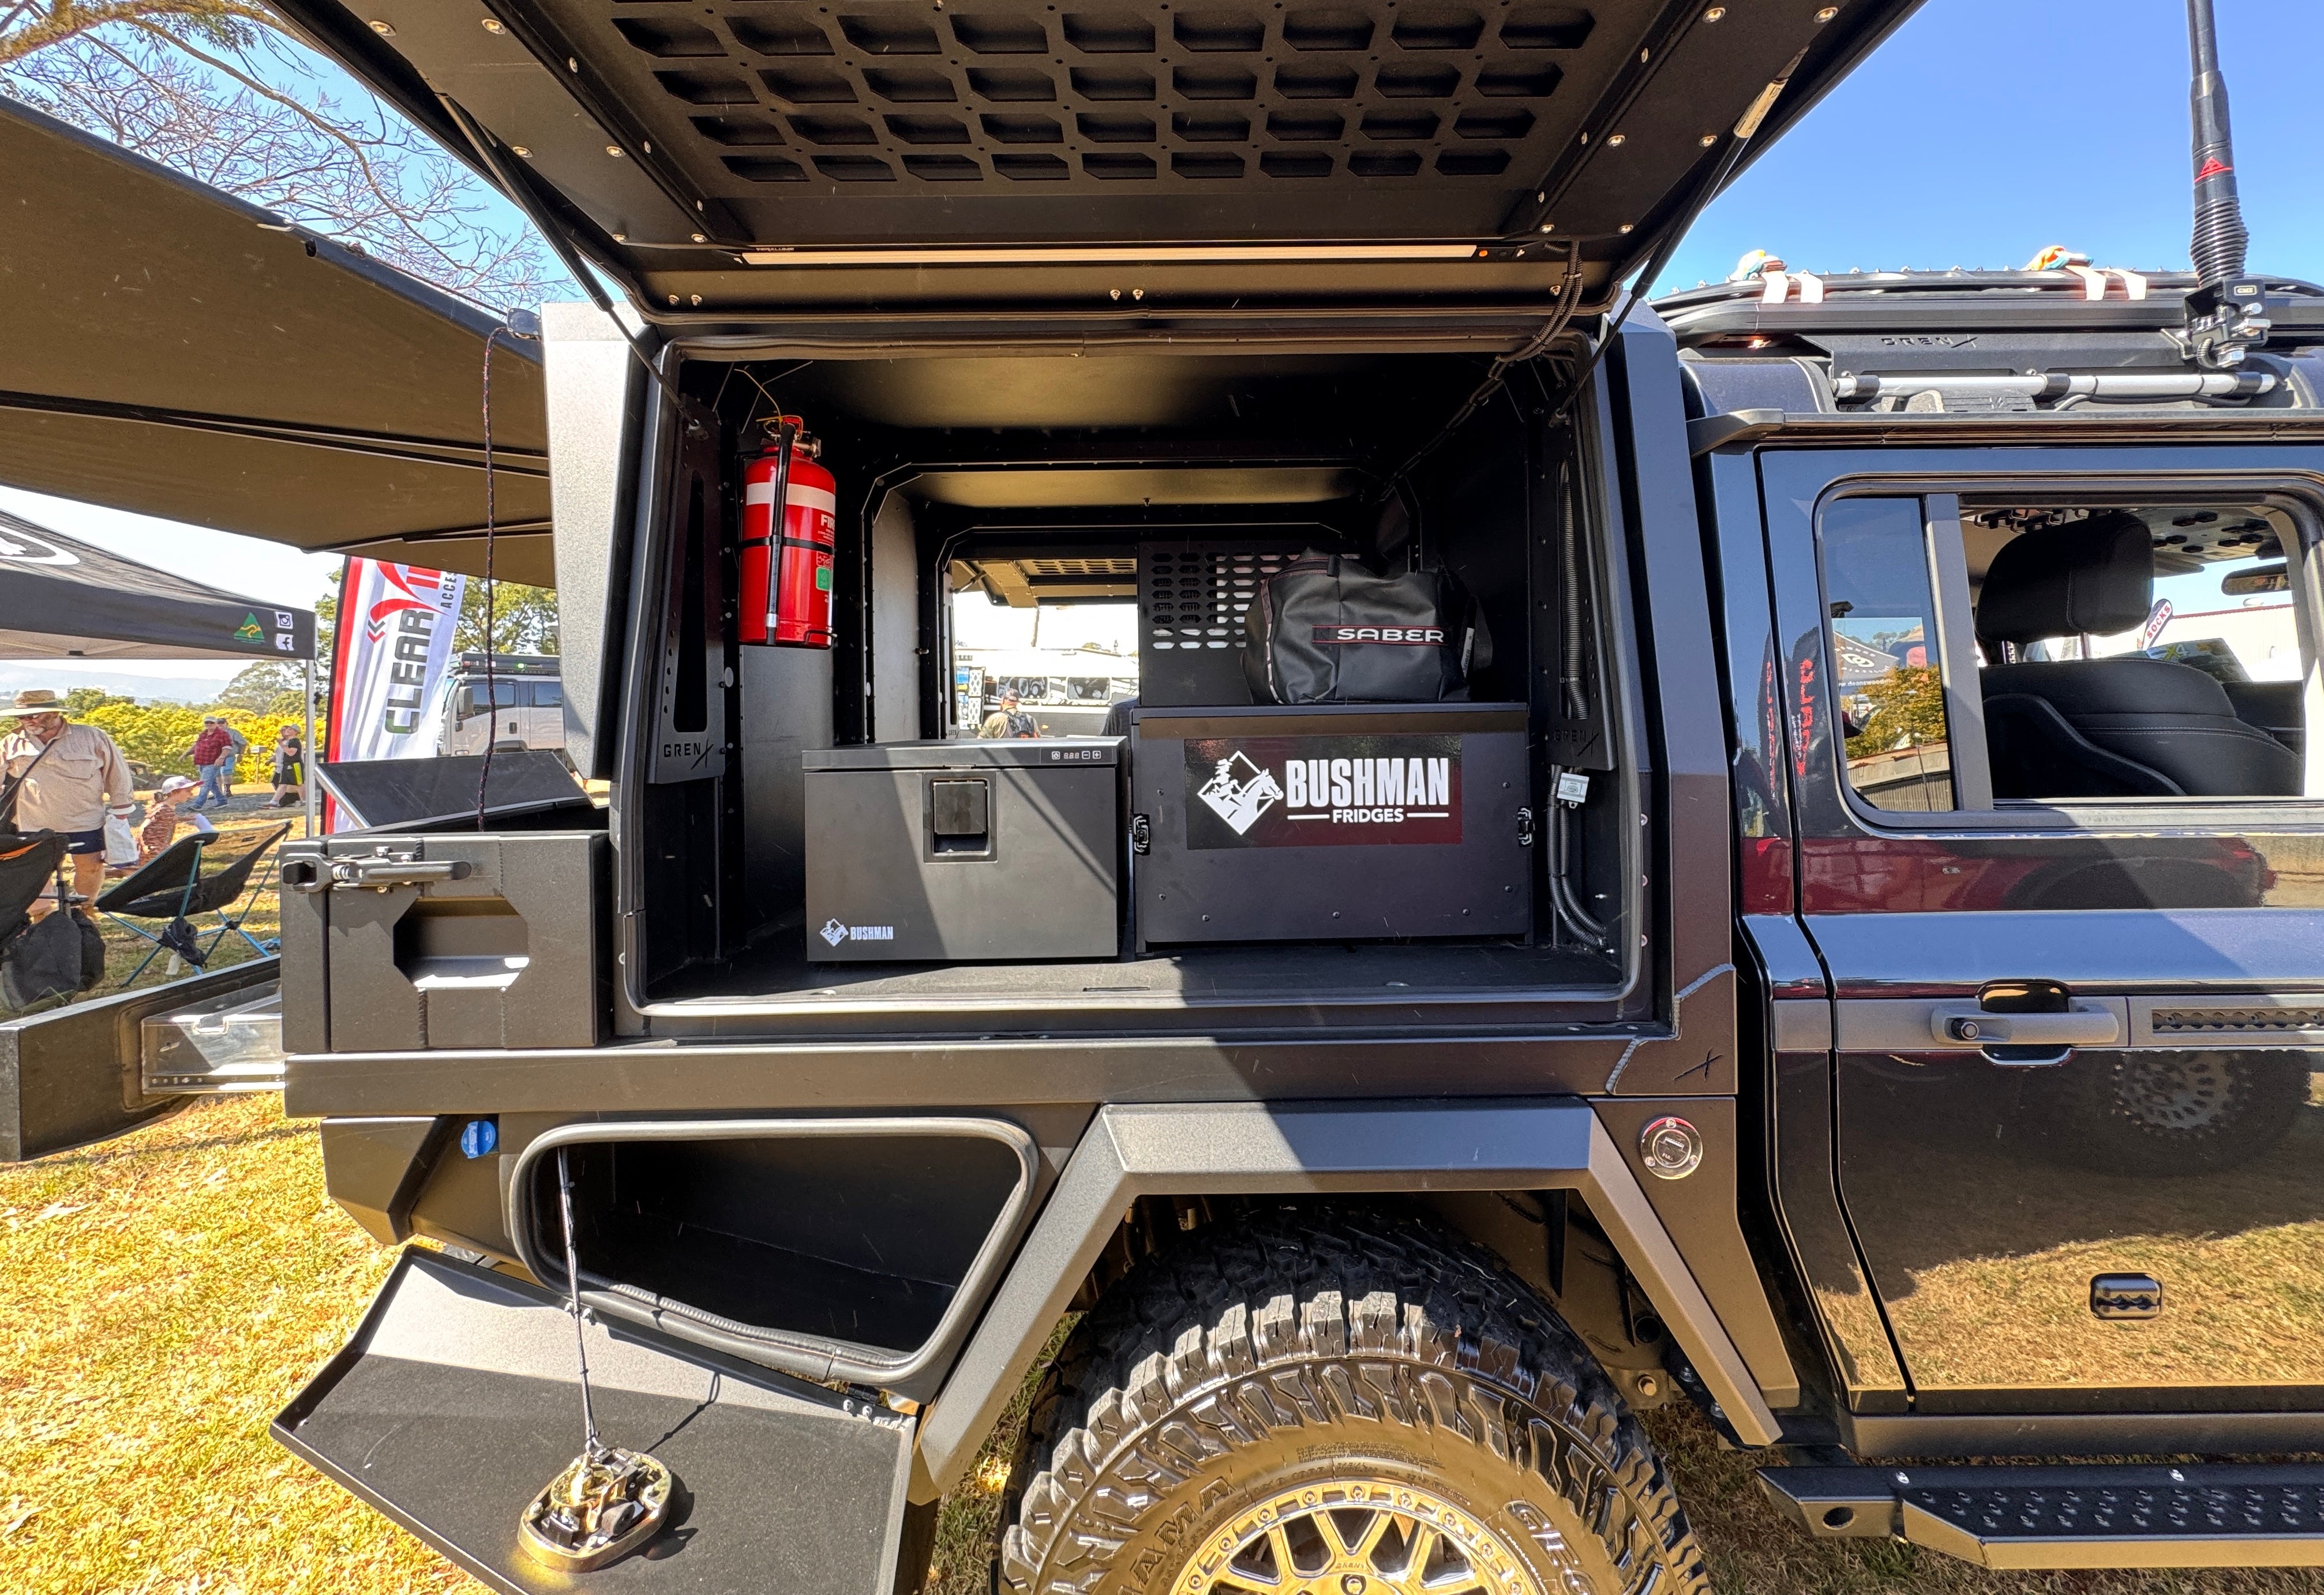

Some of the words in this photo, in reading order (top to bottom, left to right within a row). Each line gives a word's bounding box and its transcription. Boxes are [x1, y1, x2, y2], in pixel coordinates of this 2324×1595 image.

[820, 513, 835, 530] FIR
[2146, 605, 2171, 639] SOCKS
[1337, 628, 1444, 643] SABER
[1285, 757, 1449, 808] BUSHMAN
[1333, 808, 1404, 823] FRIDGES
[850, 926, 894, 940] BUSHMAN
